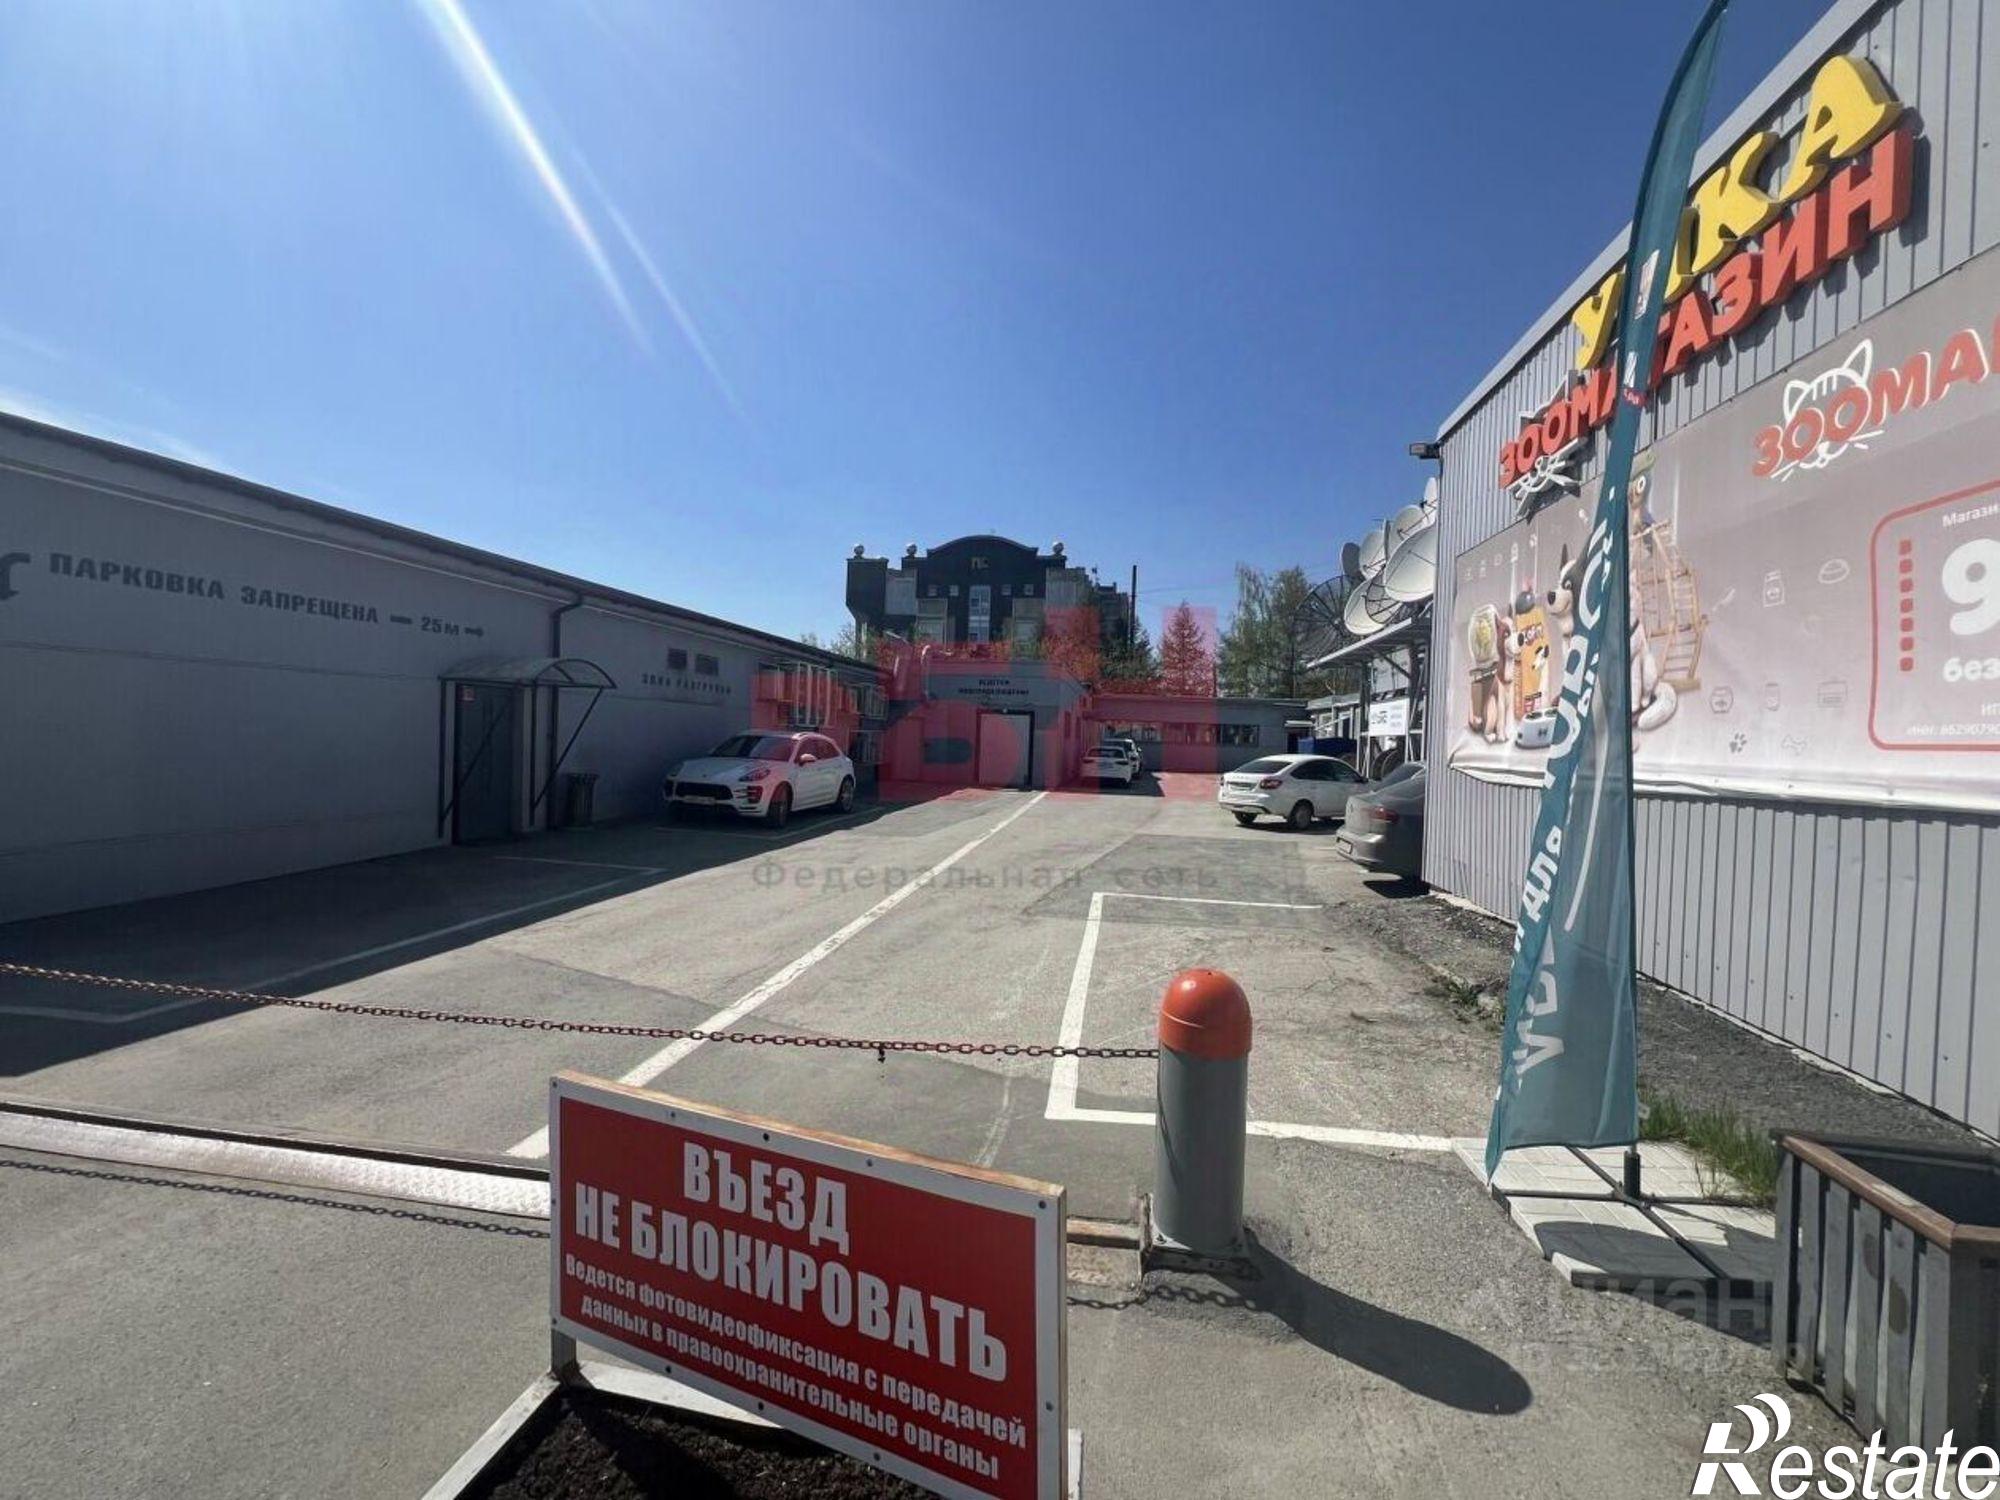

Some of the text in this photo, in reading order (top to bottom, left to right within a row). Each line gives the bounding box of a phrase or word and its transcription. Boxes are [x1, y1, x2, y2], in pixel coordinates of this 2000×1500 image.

[1572, 54, 1902, 370] УКА
[50, 552, 226, 600] ПАРКОВКА
[241, 586, 379, 624] ЗАПРЕЩЕНА
[1522, 825, 1562, 923] ДЛЯ
[575, 1182, 1008, 1382] НЕ БЛОКИРОВАТЬ
[684, 1141, 850, 1256] ВЪЕЗД
[565, 1253, 1027, 1449] Ведется фотовидеофиксация с передачей
[581, 1296, 999, 1480] данных в правоохранительные органы
